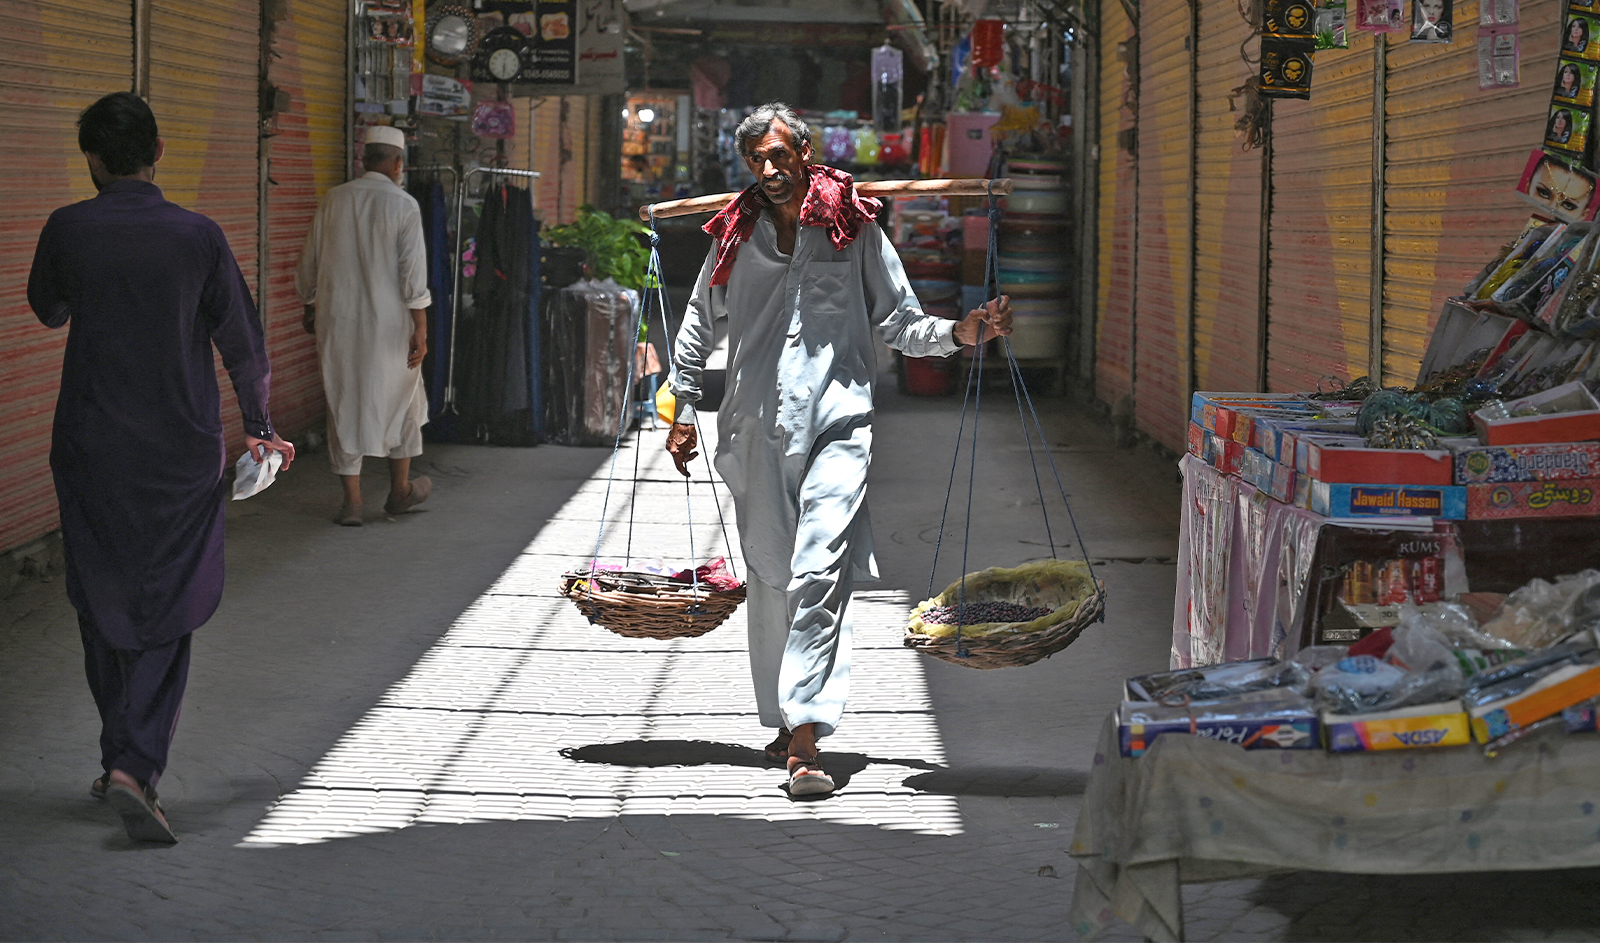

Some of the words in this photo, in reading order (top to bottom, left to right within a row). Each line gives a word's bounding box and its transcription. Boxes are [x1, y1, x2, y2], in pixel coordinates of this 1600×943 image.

[1517, 452, 1590, 480] Standard
[1353, 489, 1395, 507] Jawaid
[1397, 491, 1440, 509] Hassan
[1392, 728, 1449, 747] ASDA
